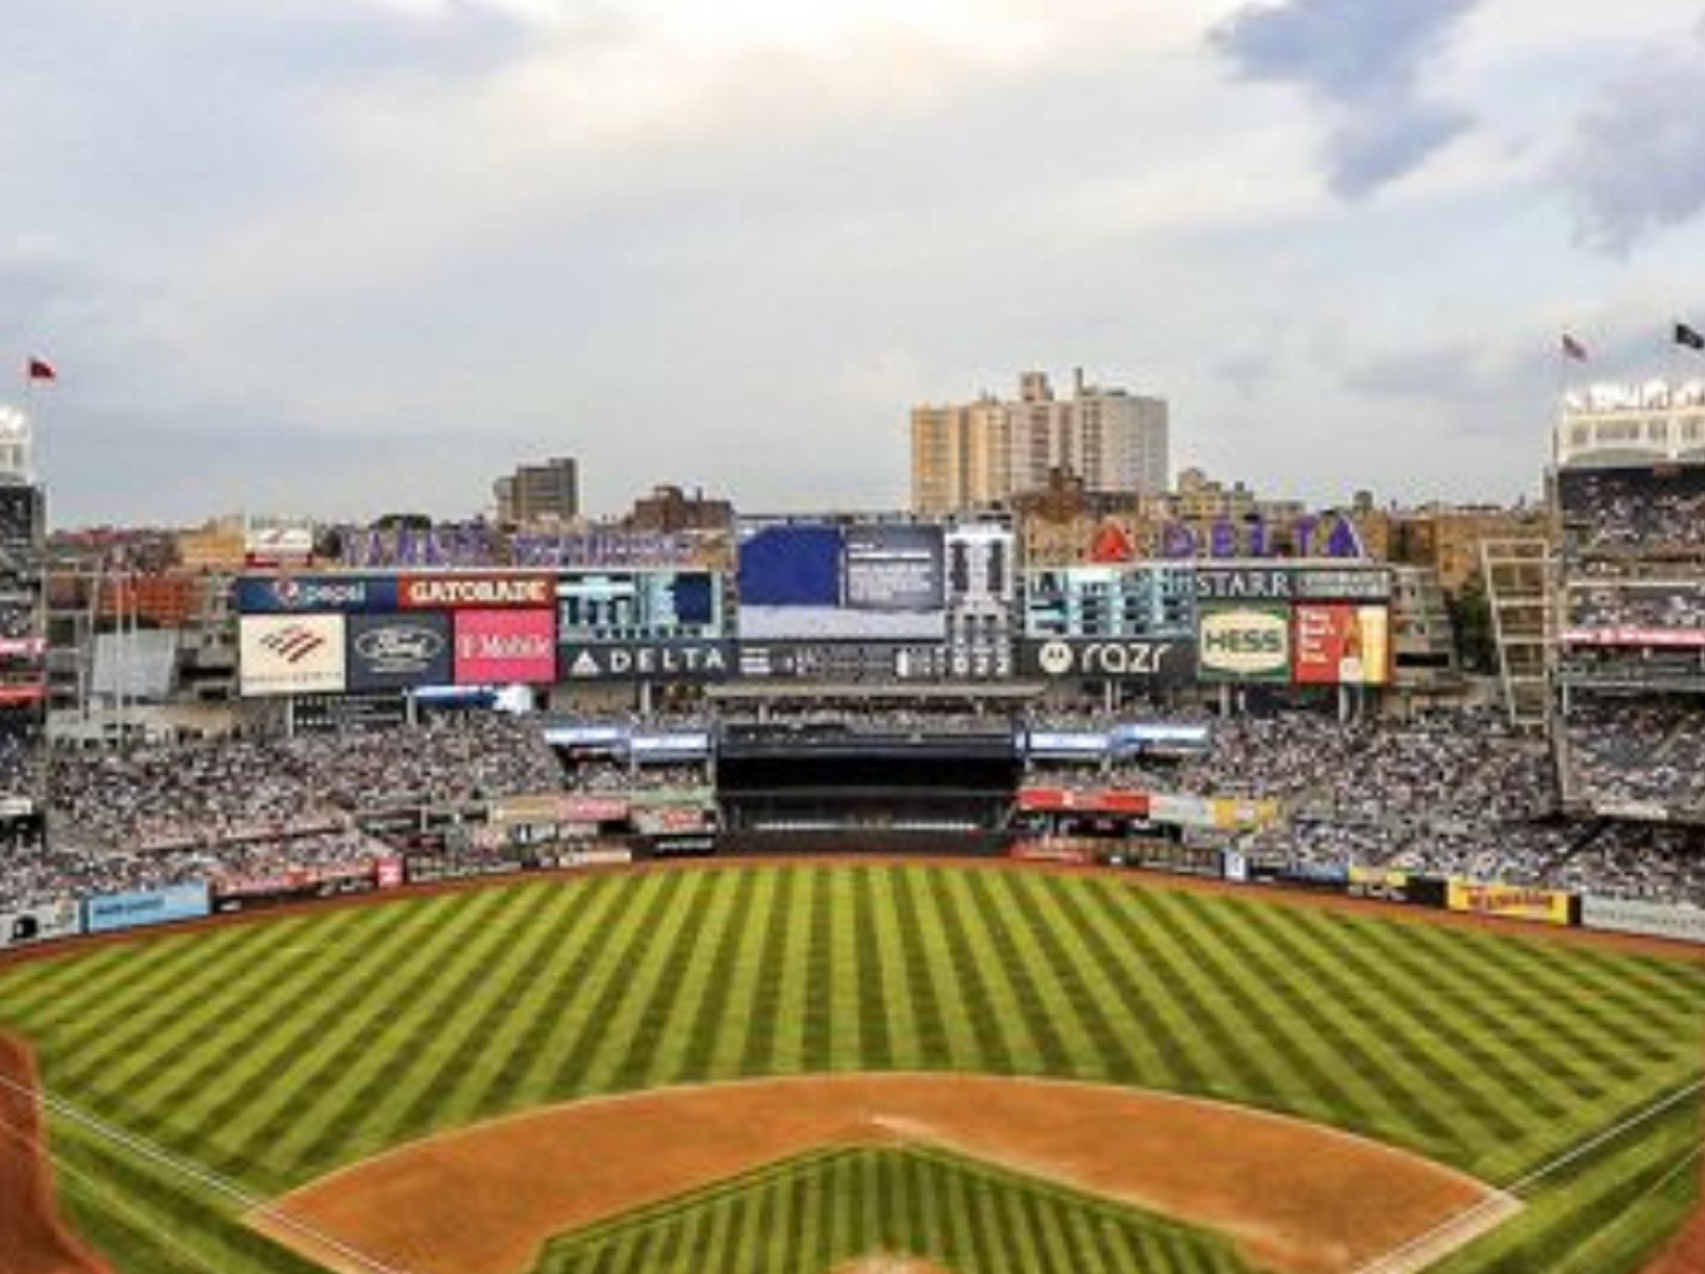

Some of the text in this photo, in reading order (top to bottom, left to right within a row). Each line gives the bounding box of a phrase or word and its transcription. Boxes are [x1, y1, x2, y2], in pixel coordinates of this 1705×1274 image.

[302, 581, 366, 606] pepsi
[409, 580, 547, 602] GATORADE
[1197, 570, 1291, 598] STARR
[1205, 629, 1282, 653] HESS
[608, 646, 727, 673] DELTA
[1081, 641, 1174, 673] razr
